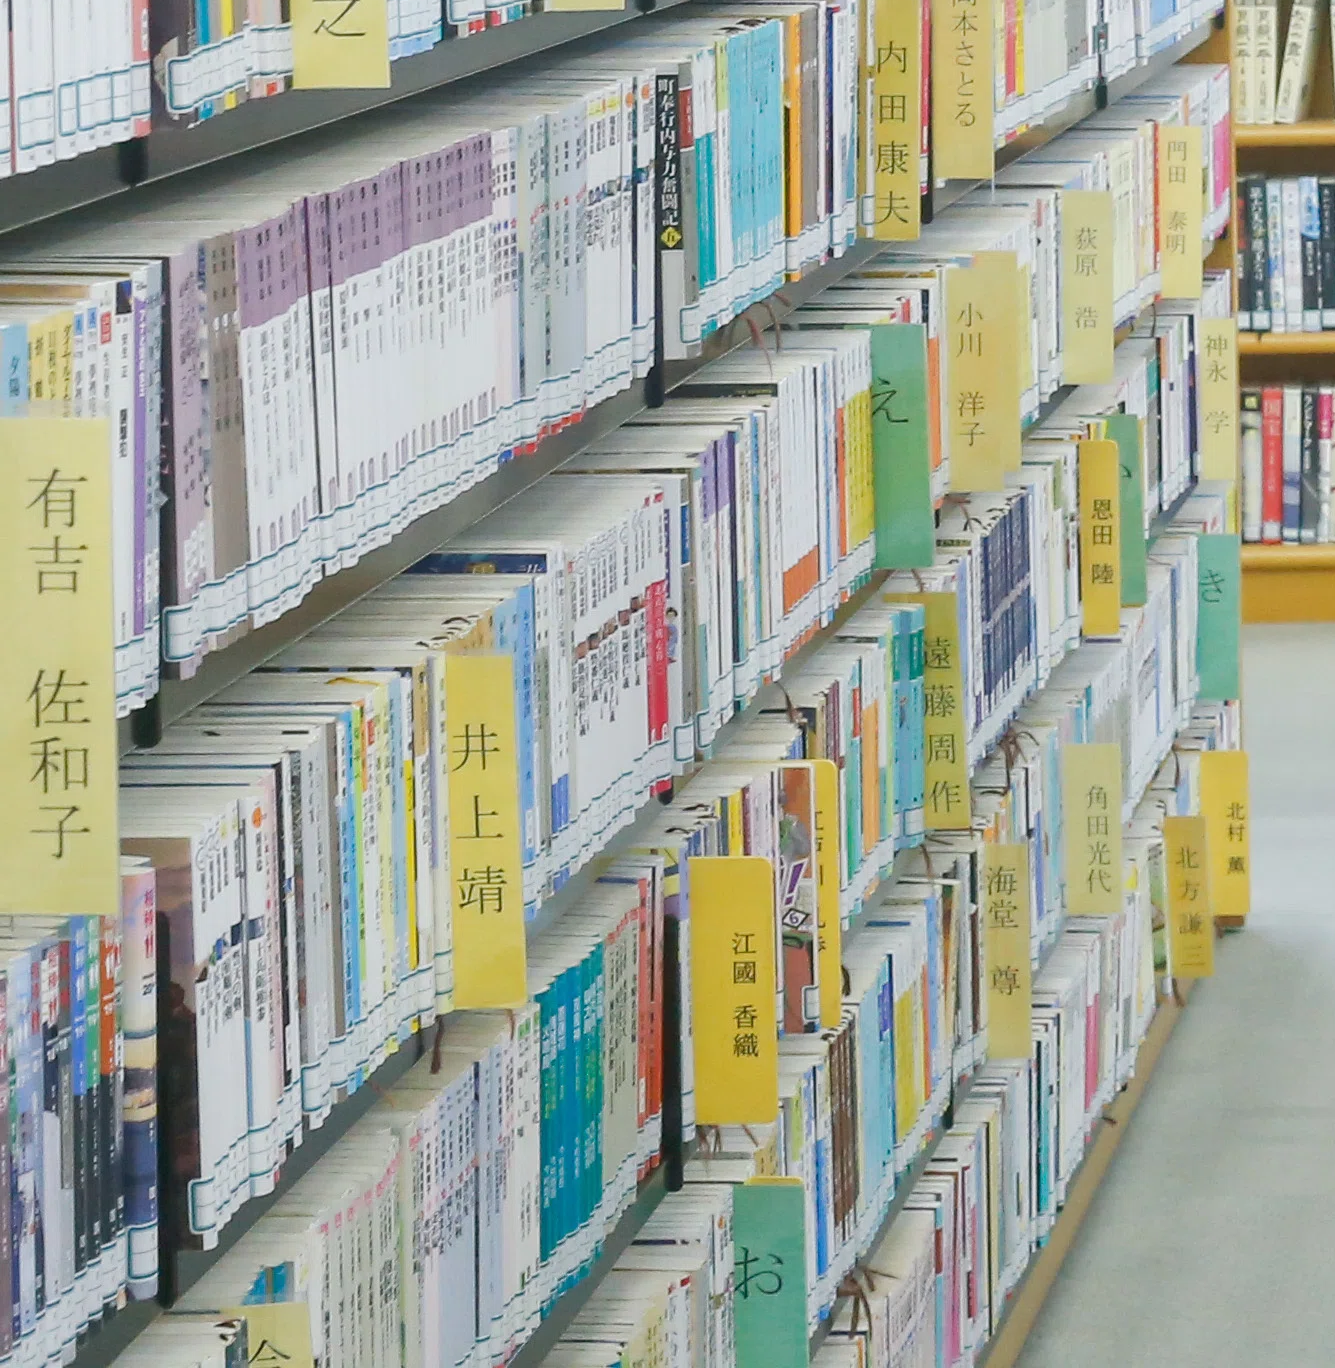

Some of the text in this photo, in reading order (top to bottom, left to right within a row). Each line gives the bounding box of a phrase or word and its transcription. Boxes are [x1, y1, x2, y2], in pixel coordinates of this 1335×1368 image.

[876, 40, 910, 225] 内田康夫
[1165, 140, 1188, 255] 門田 泰明
[1074, 226, 1098, 329] 荻原 浩
[869, 377, 909, 424] え
[956, 302, 986, 448] 小川 洋子
[1204, 334, 1230, 435] 神永 学
[27, 468, 89, 595] 有吉
[1091, 499, 1114, 585] 恩田 陸
[1198, 569, 1225, 603] き
[27, 669, 91, 860] 佐和子
[924, 637, 961, 813] 遠藤周作
[452, 723, 508, 915] 井上靖
[1087, 785, 1112, 894] 角田光代
[987, 865, 1021, 996] 海堂 尊
[1177, 845, 1206, 967] 北方謙三
[731, 932, 759, 1058] 江國 香織
[733, 1246, 784, 1300] お
